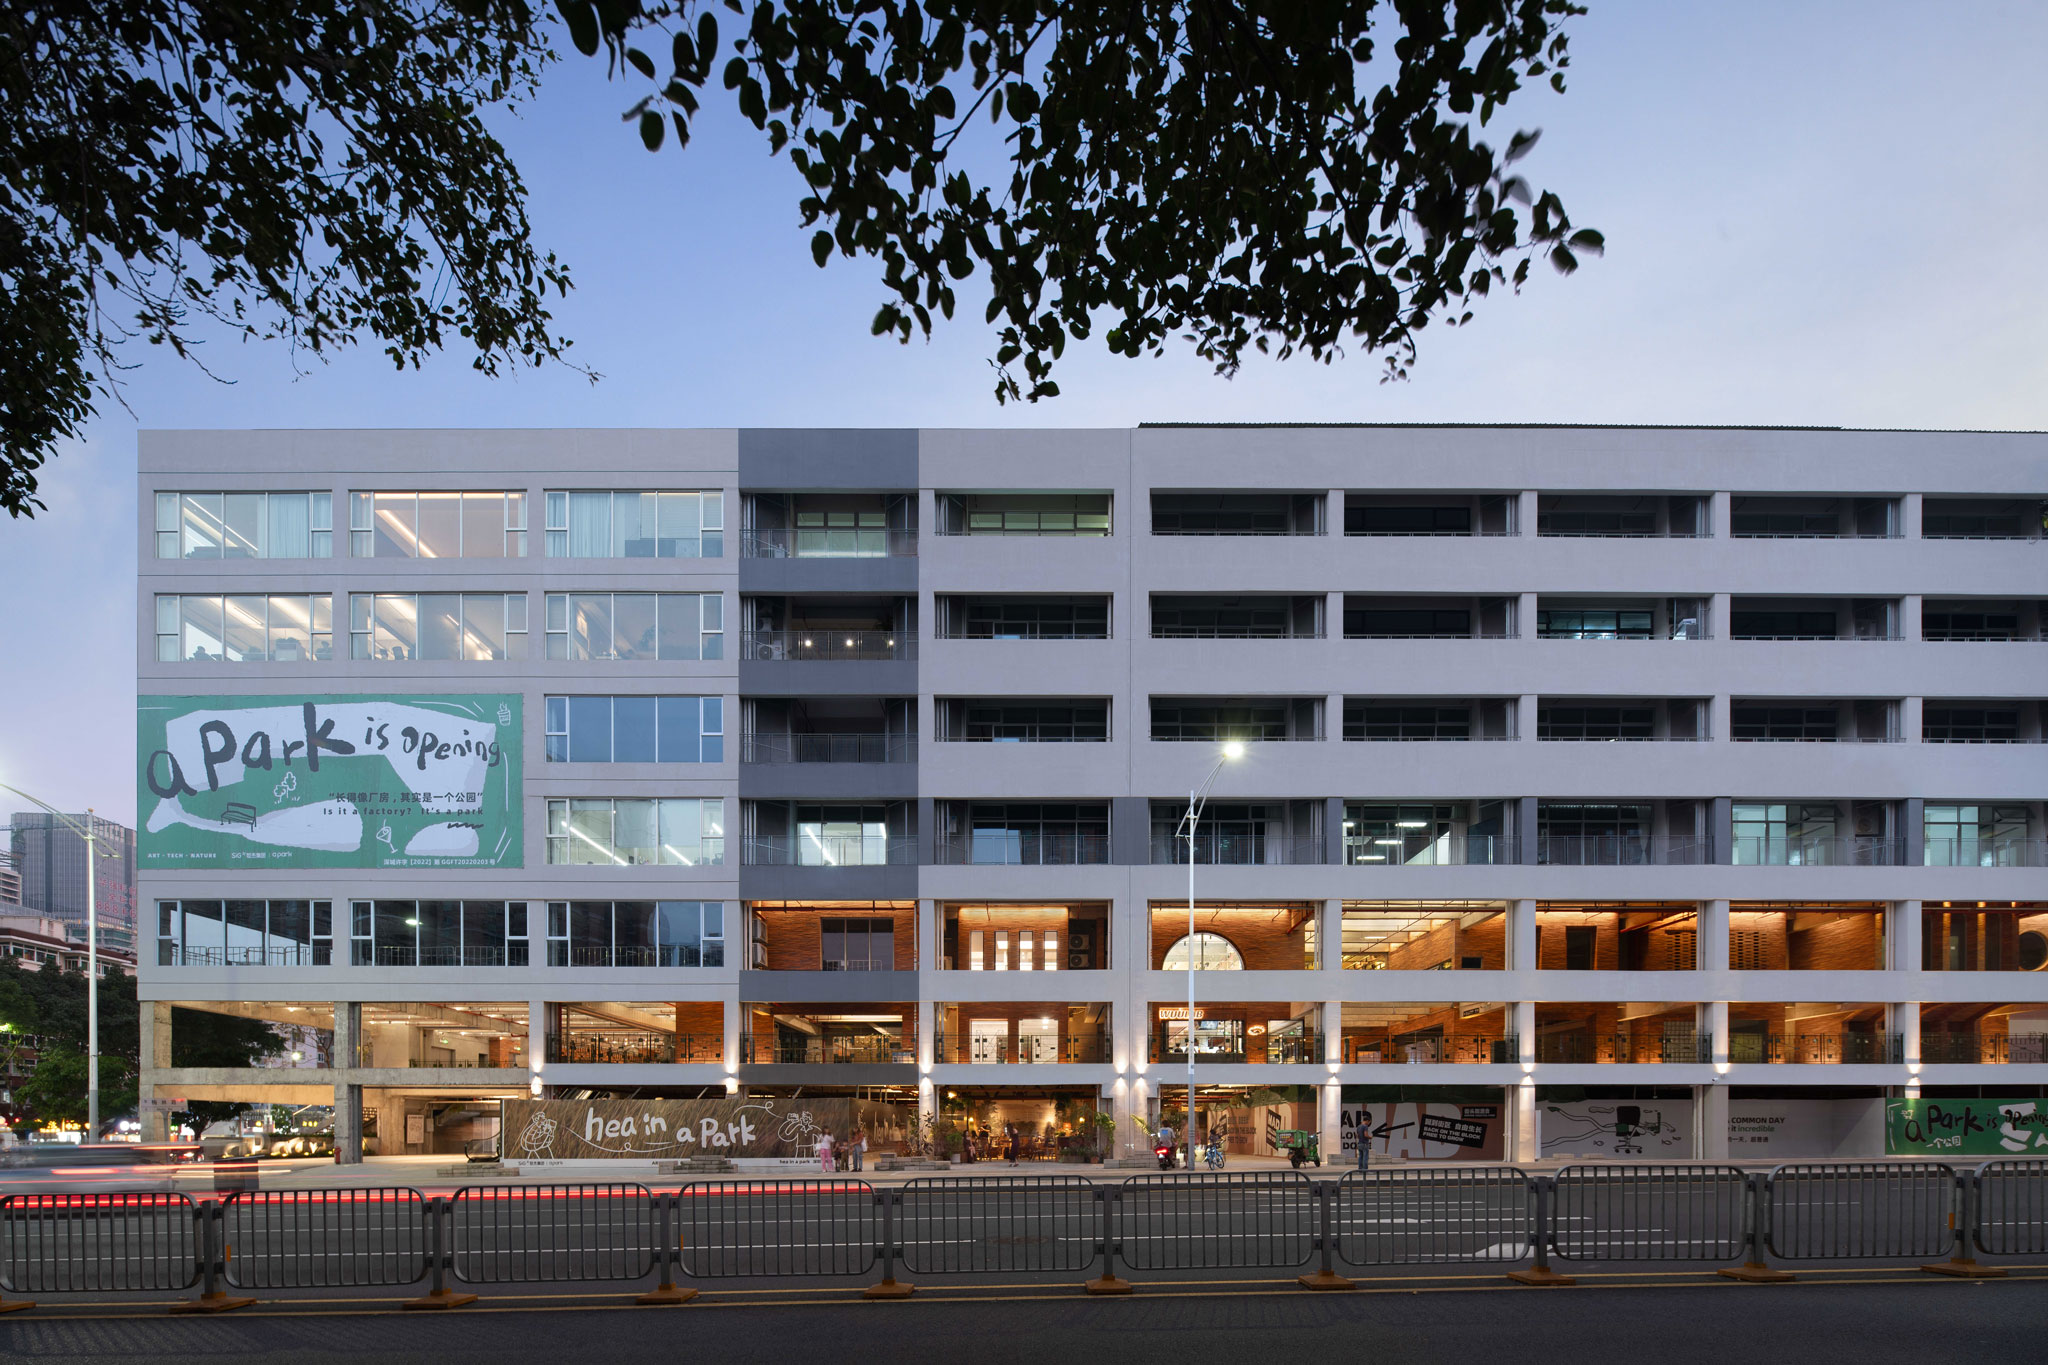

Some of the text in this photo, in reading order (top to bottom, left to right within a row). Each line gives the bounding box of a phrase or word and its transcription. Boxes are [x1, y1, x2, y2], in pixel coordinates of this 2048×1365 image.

[147, 751, 197, 799] a
[200, 702, 355, 792] Park
[366, 717, 390, 750] is
[323, 807, 333, 815] Is
[338, 807, 347, 815] it
[363, 807, 412, 817] factory?
[457, 807, 484, 817] park
[586, 1108, 756, 1149] hea in a Park
[1905, 1120, 1926, 1142] a
[1927, 1104, 1984, 1136] Park
[1986, 1113, 1998, 1129] is
